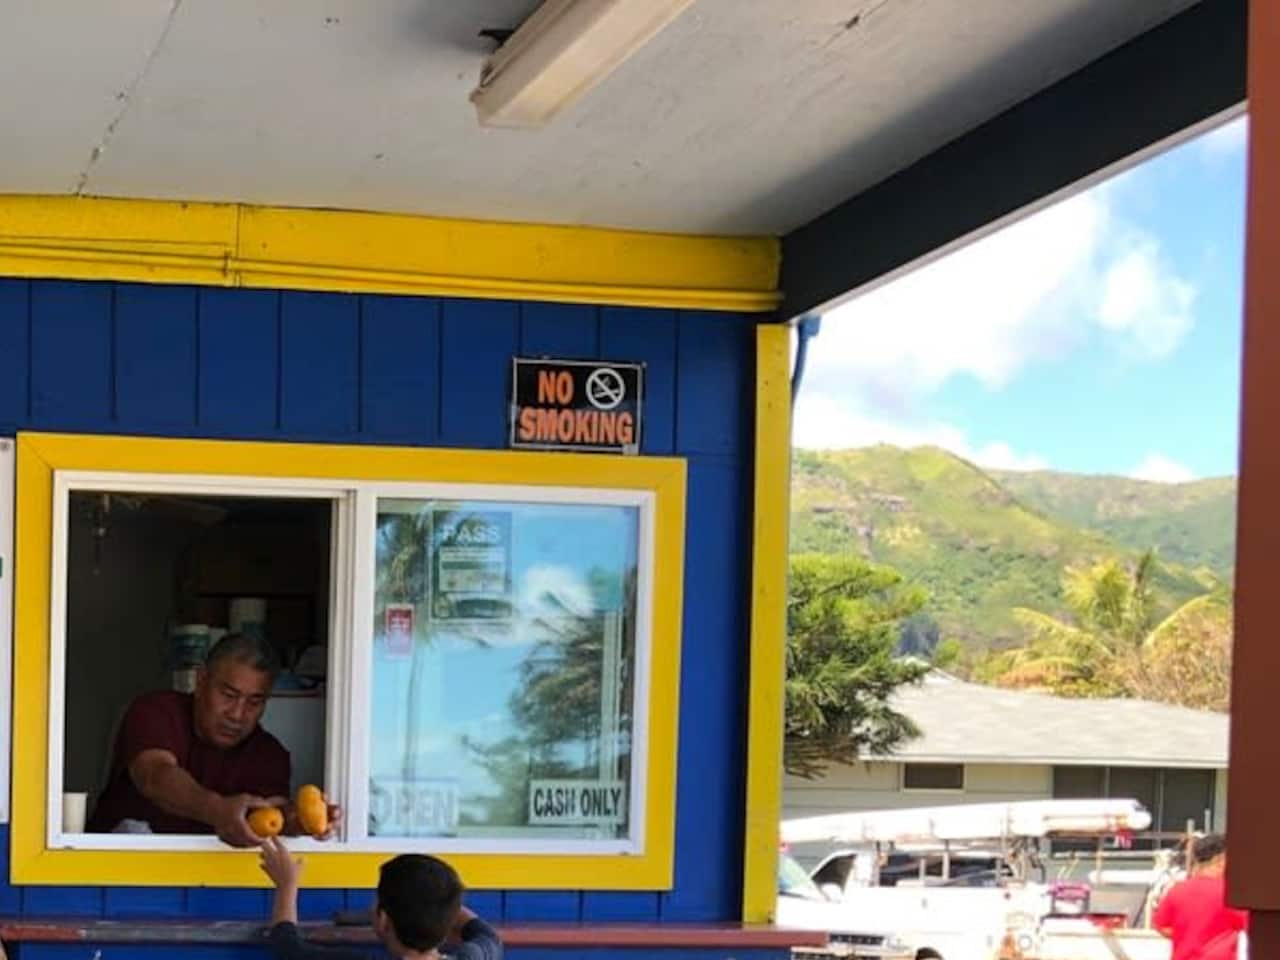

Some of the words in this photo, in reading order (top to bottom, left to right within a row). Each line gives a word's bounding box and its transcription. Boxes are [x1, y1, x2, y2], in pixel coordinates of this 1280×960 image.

[538, 370, 574, 403] NO
[519, 407, 634, 444] SMOKING
[441, 523, 501, 543] PASS
[533, 788, 576, 817] CASH
[581, 788, 621, 816] ONLY
